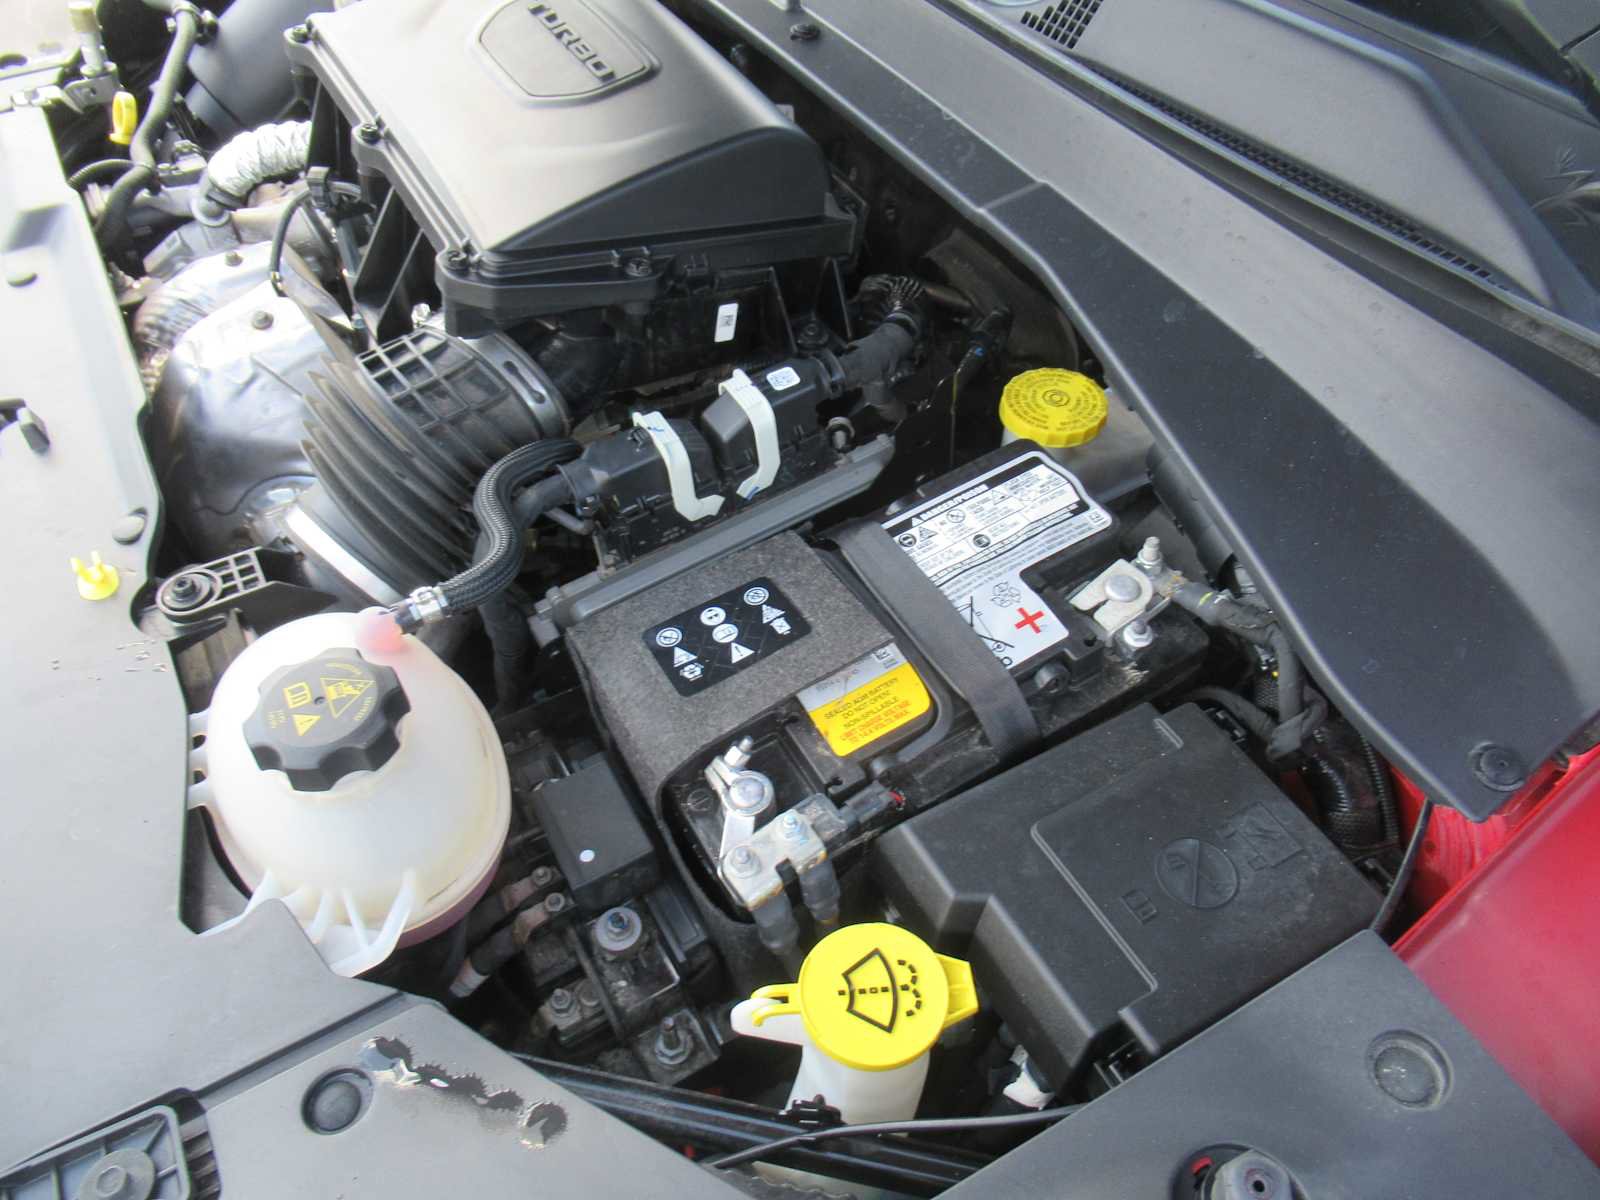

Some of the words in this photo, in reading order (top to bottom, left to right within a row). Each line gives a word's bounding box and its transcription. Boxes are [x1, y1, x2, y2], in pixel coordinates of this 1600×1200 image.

[528, 0, 616, 82] TURBO
[824, 701, 852, 719] SEALED
[869, 677, 897, 697] BATTERY
[842, 709, 854, 719] DO
[854, 702, 868, 713] NOT
